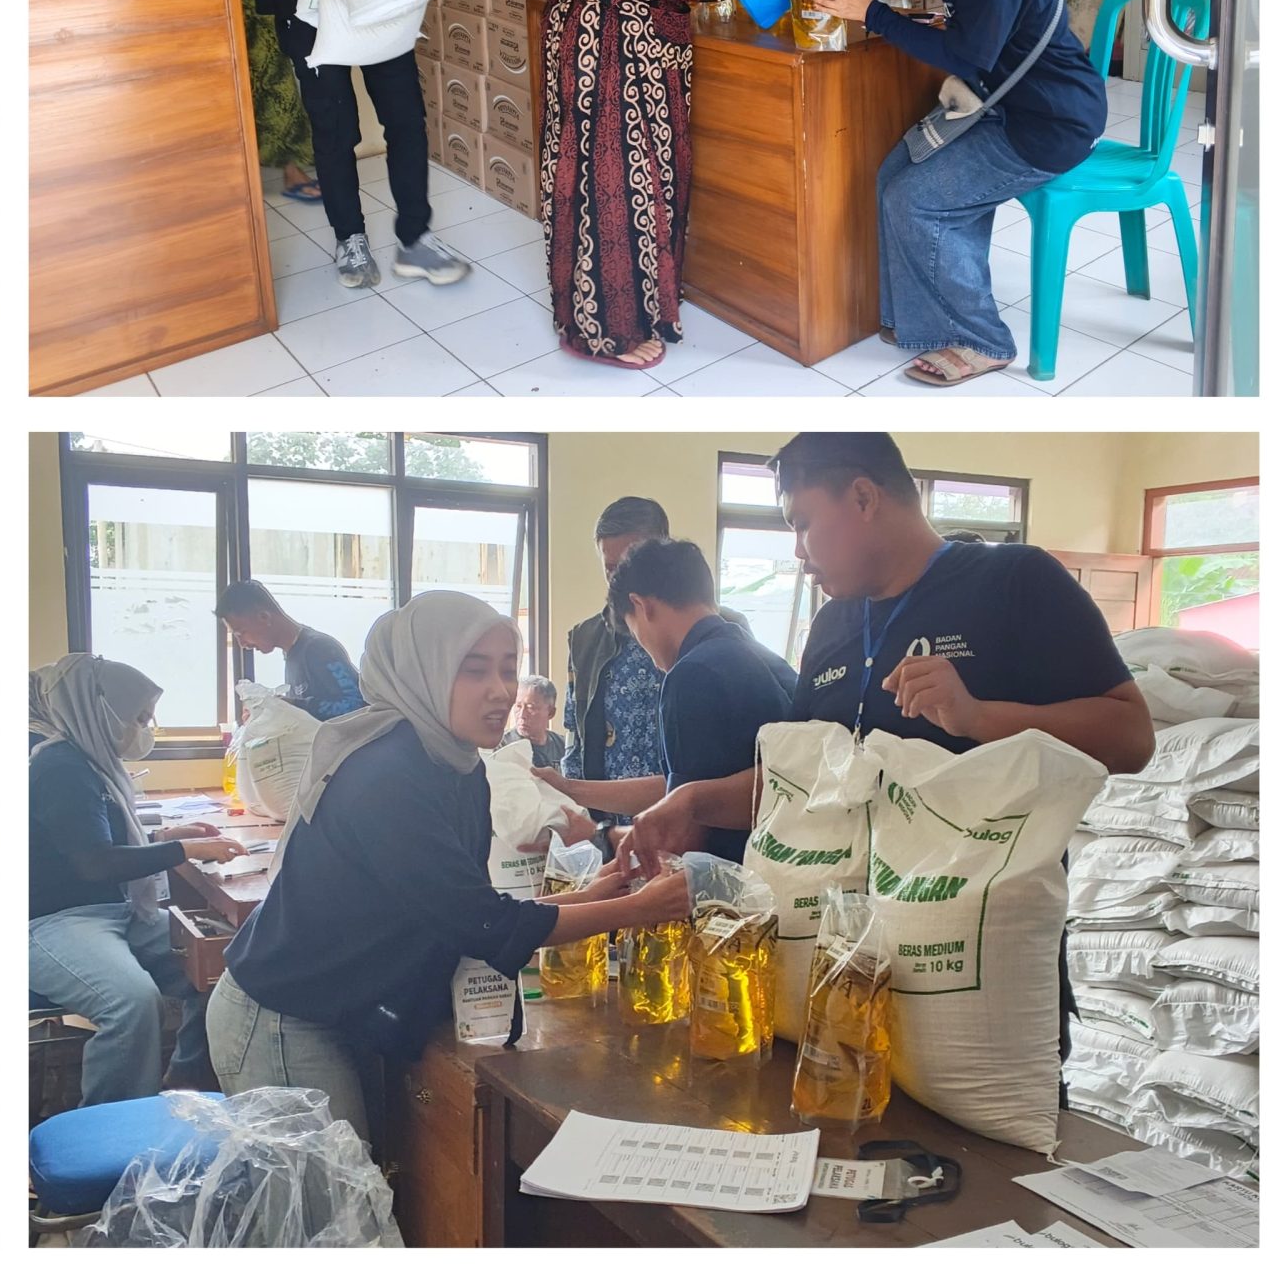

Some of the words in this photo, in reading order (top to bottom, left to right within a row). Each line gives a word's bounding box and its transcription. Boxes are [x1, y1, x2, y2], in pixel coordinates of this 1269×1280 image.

[935, 634, 962, 644] BADAN
[935, 642, 968, 651] PANGAN
[789, 843, 853, 867] PANGA
[501, 860, 520, 869] BERAS
[793, 895, 819, 909] BERAS
[898, 944, 922, 957] BERAS
[924, 940, 965, 957] MEDIUM
[930, 960, 944, 973] 10
[946, 959, 964, 973] kg
[467, 974, 503, 985] PETUGAS
[463, 983, 509, 996] PELAKSANA
